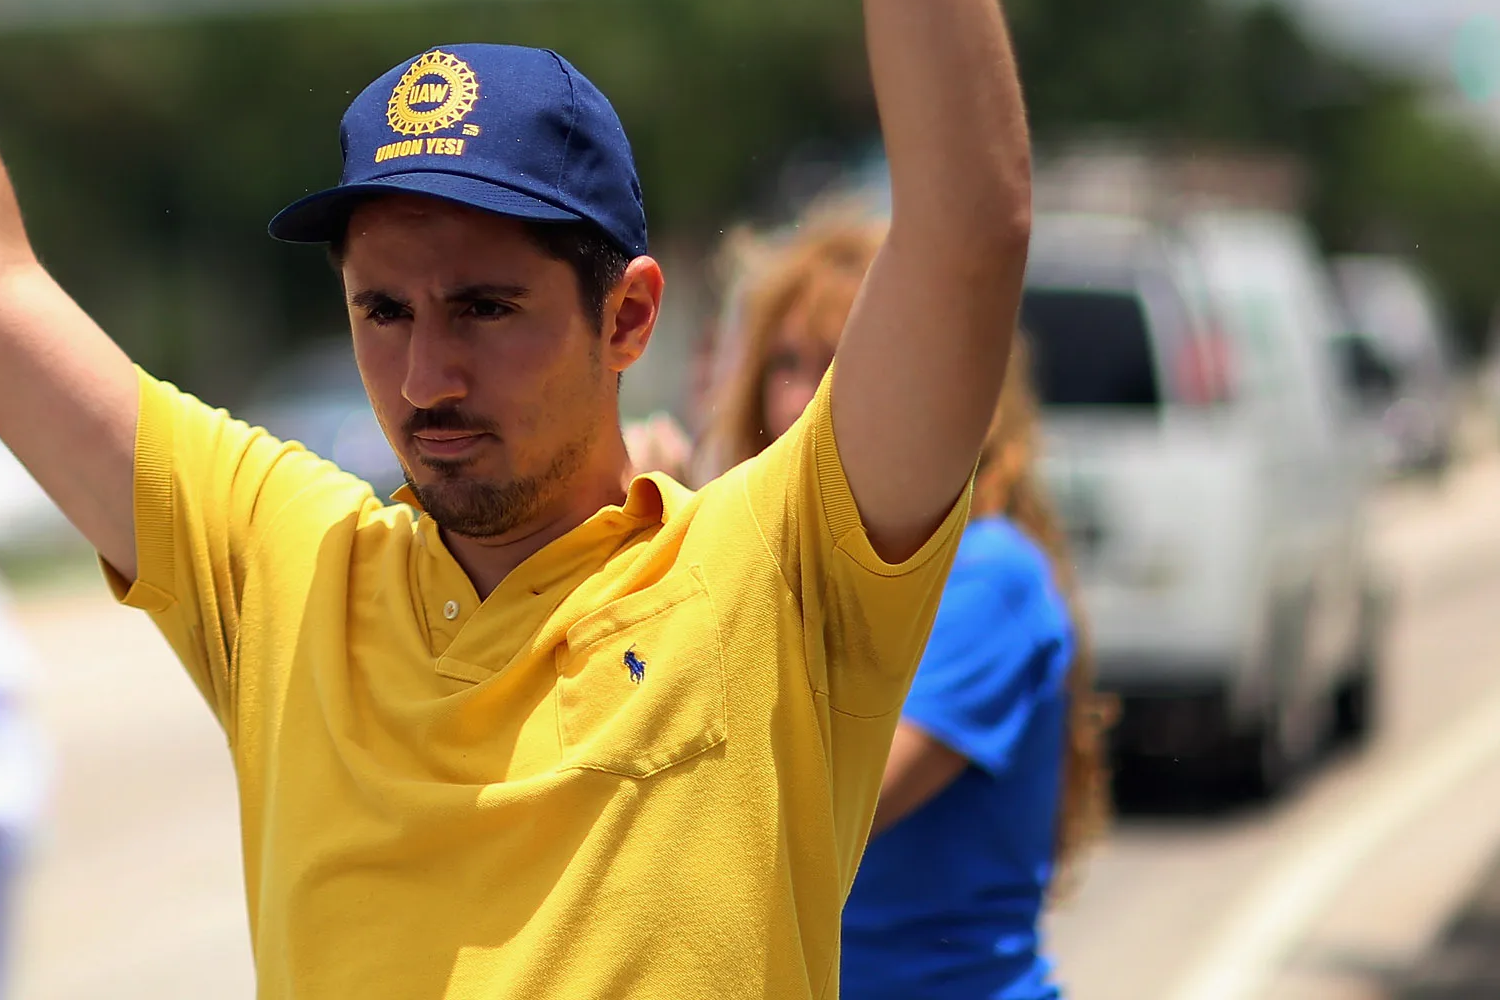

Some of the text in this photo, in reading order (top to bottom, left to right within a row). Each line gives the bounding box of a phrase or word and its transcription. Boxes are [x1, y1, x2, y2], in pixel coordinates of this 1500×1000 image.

[409, 83, 449, 105] UAW
[375, 138, 464, 163] UNION YES!
